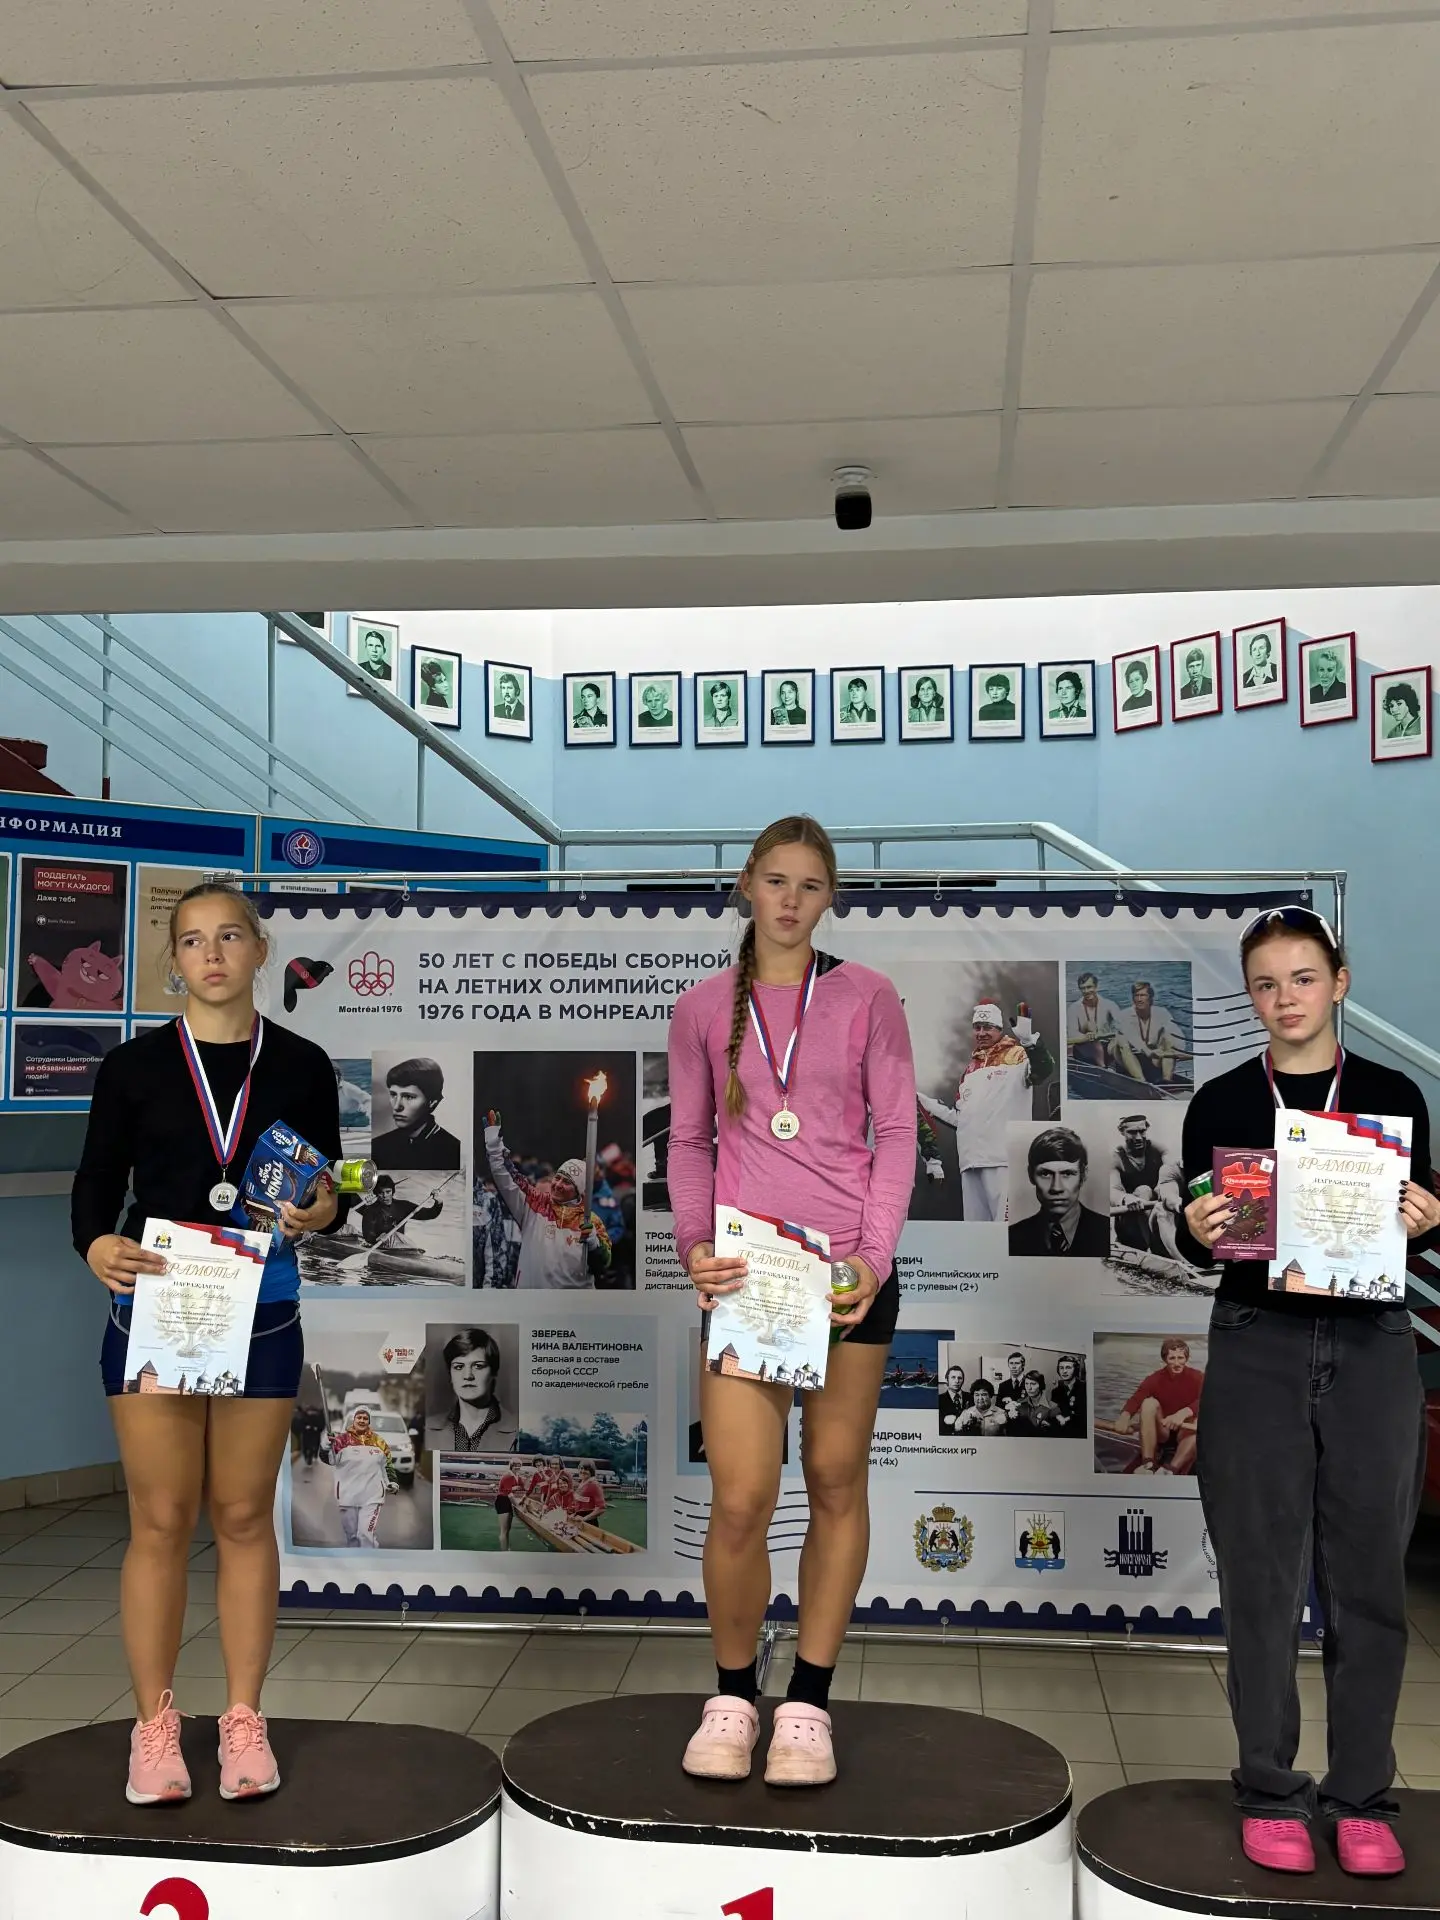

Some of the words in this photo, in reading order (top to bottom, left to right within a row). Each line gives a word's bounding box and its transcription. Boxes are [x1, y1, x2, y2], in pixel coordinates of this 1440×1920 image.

[37, 871, 87, 881] ПОДДЕЛАТЬ
[37, 880, 65, 889] МОГУТ
[67, 882, 111, 892] КАЖДОГО!
[36, 894, 57, 902] Даже
[59, 895, 76, 903] тебя
[418, 953, 445, 969] 50
[452, 953, 495, 969] ЛЕТ
[502, 953, 516, 969] С
[524, 952, 617, 971] ПОБЕДЫ
[625, 949, 731, 969] СБОРНОЙ
[419, 978, 449, 994] НА
[455, 978, 543, 994] ЛЕТНИХ
[338, 1005, 380, 1013] Montréal
[381, 1005, 403, 1013] 1976
[418, 1004, 464, 1020] 1976
[471, 1004, 532, 1023] ГОДА
[538, 1004, 552, 1020] В
[559, 1004, 676, 1020] МОНРЕАЛЕ
[271, 1129, 293, 1146] TONDI
[1297, 1156, 1386, 1175] ГРАМОТА
[264, 1160, 284, 1200] TONDI
[645, 1244, 674, 1252] НИНА
[645, 1269, 689, 1279] Байдарка
[916, 1269, 981, 1279] Олимпийских
[982, 1271, 999, 1280] игр
[644, 1283, 694, 1291] дистанция
[917, 1283, 958, 1292] рулевым
[959, 1282, 979, 1292] (2+)
[531, 1330, 577, 1338] ЗВЕРЕВА
[531, 1342, 560, 1351] НИНА
[562, 1342, 644, 1352] ВАЛЕНТИНОВНА
[531, 1355, 575, 1363] Запасная
[531, 1367, 571, 1376] сборной
[573, 1367, 599, 1375] СССР
[545, 1380, 616, 1389] академической
[617, 1381, 649, 1390] гребле
[872, 1432, 922, 1441] НДРОВИЧ
[894, 1445, 959, 1455] Олимпийских
[960, 1447, 977, 1456] игр
